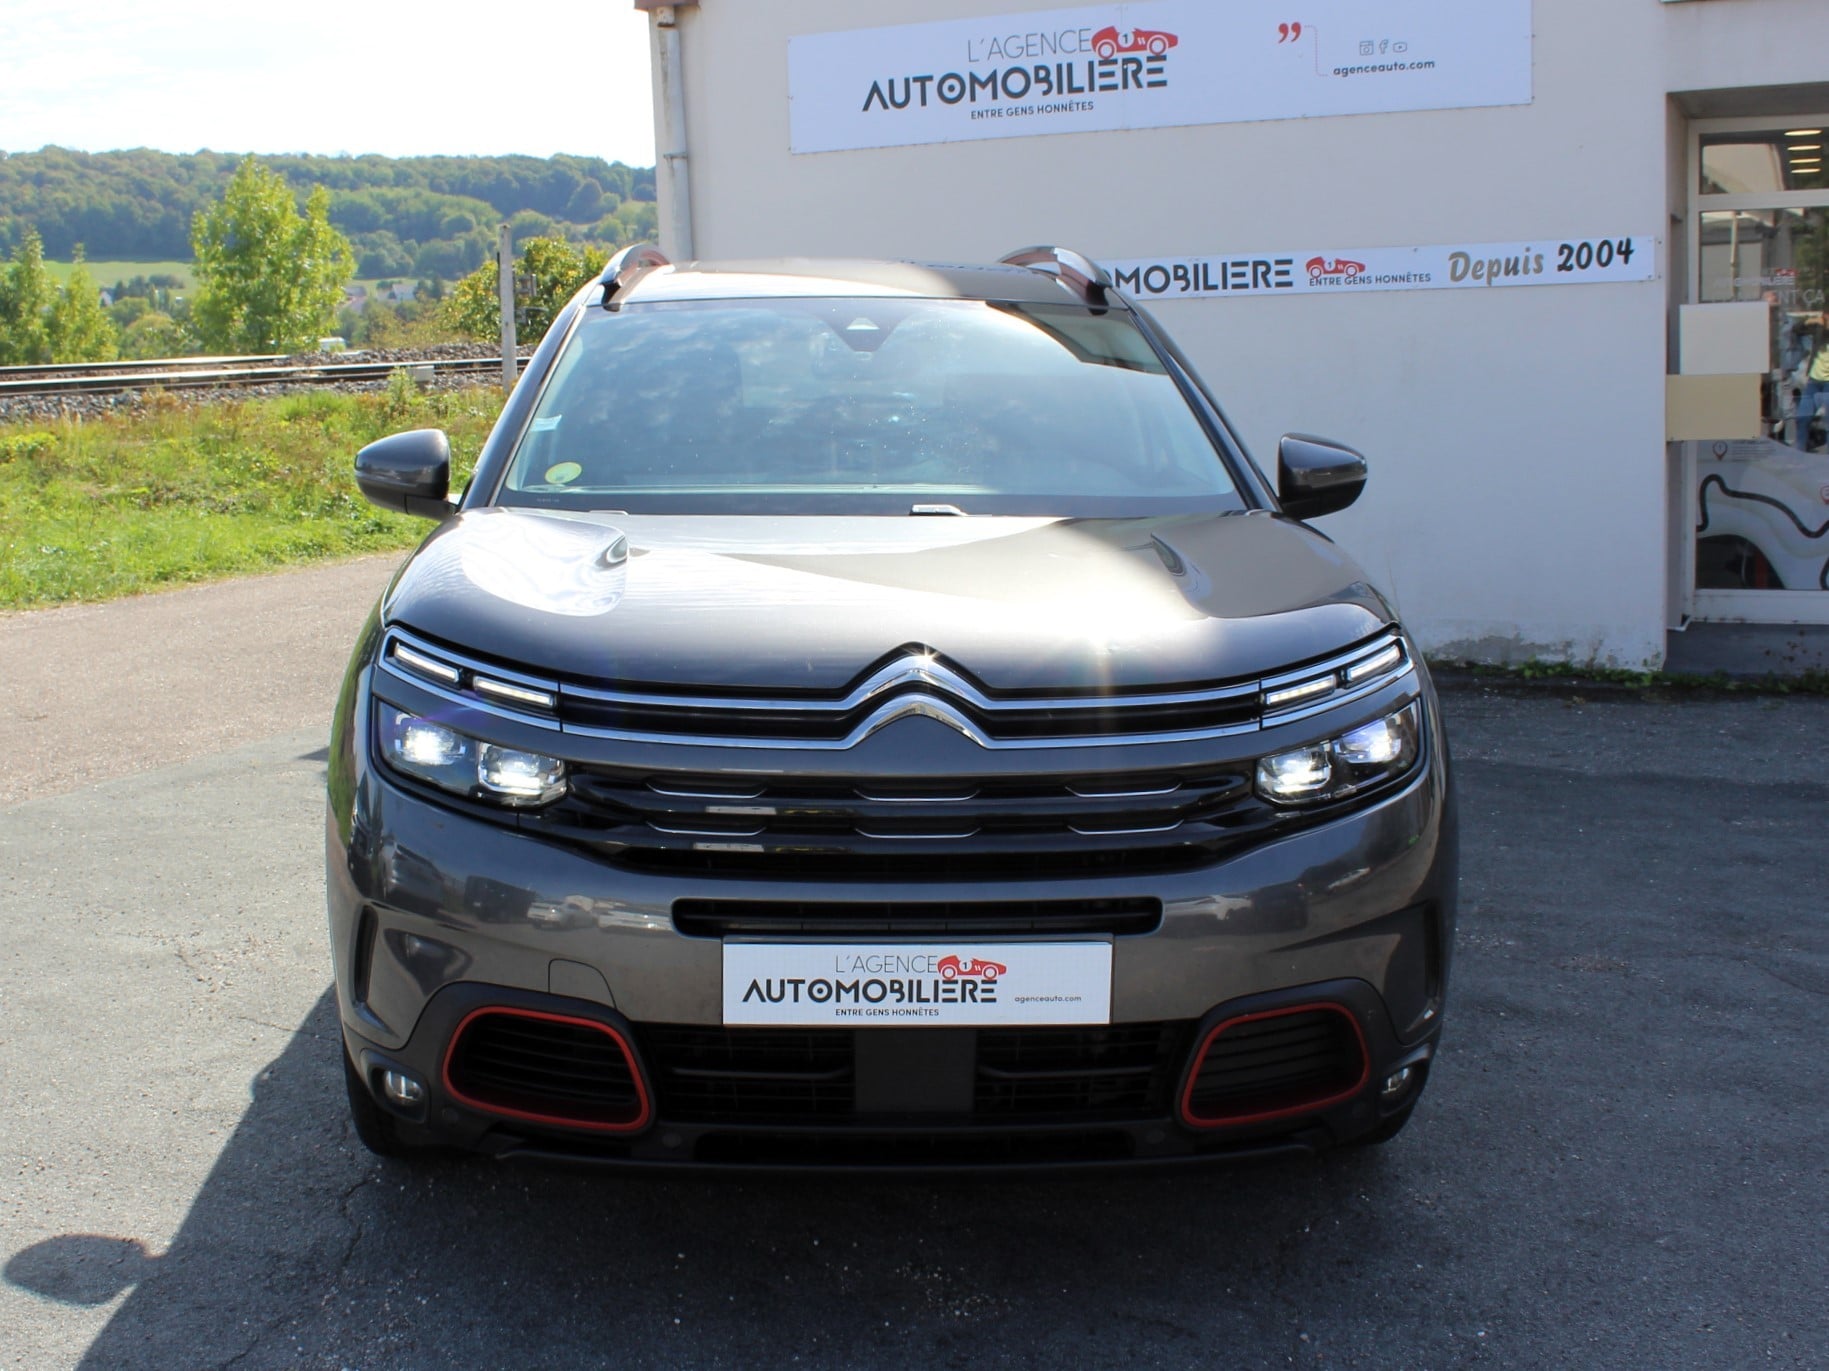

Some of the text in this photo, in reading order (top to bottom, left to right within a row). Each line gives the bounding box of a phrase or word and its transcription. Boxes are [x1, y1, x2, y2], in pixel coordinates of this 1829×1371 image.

[967, 28, 1092, 63] L'AGENCE
[1332, 59, 1436, 78] agenceauto.com
[970, 100, 1095, 120] ENTRE GENS HONNÊTES
[1448, 237, 1635, 287] Depuis 2004
[1309, 271, 1431, 287] ENTRE GENS HONNÊTES
[835, 955, 939, 973] L'AGENCE
[1014, 994, 1082, 1003] agenceauto.com
[835, 1006, 940, 1017] ENTRE GENS HONNÊTES
